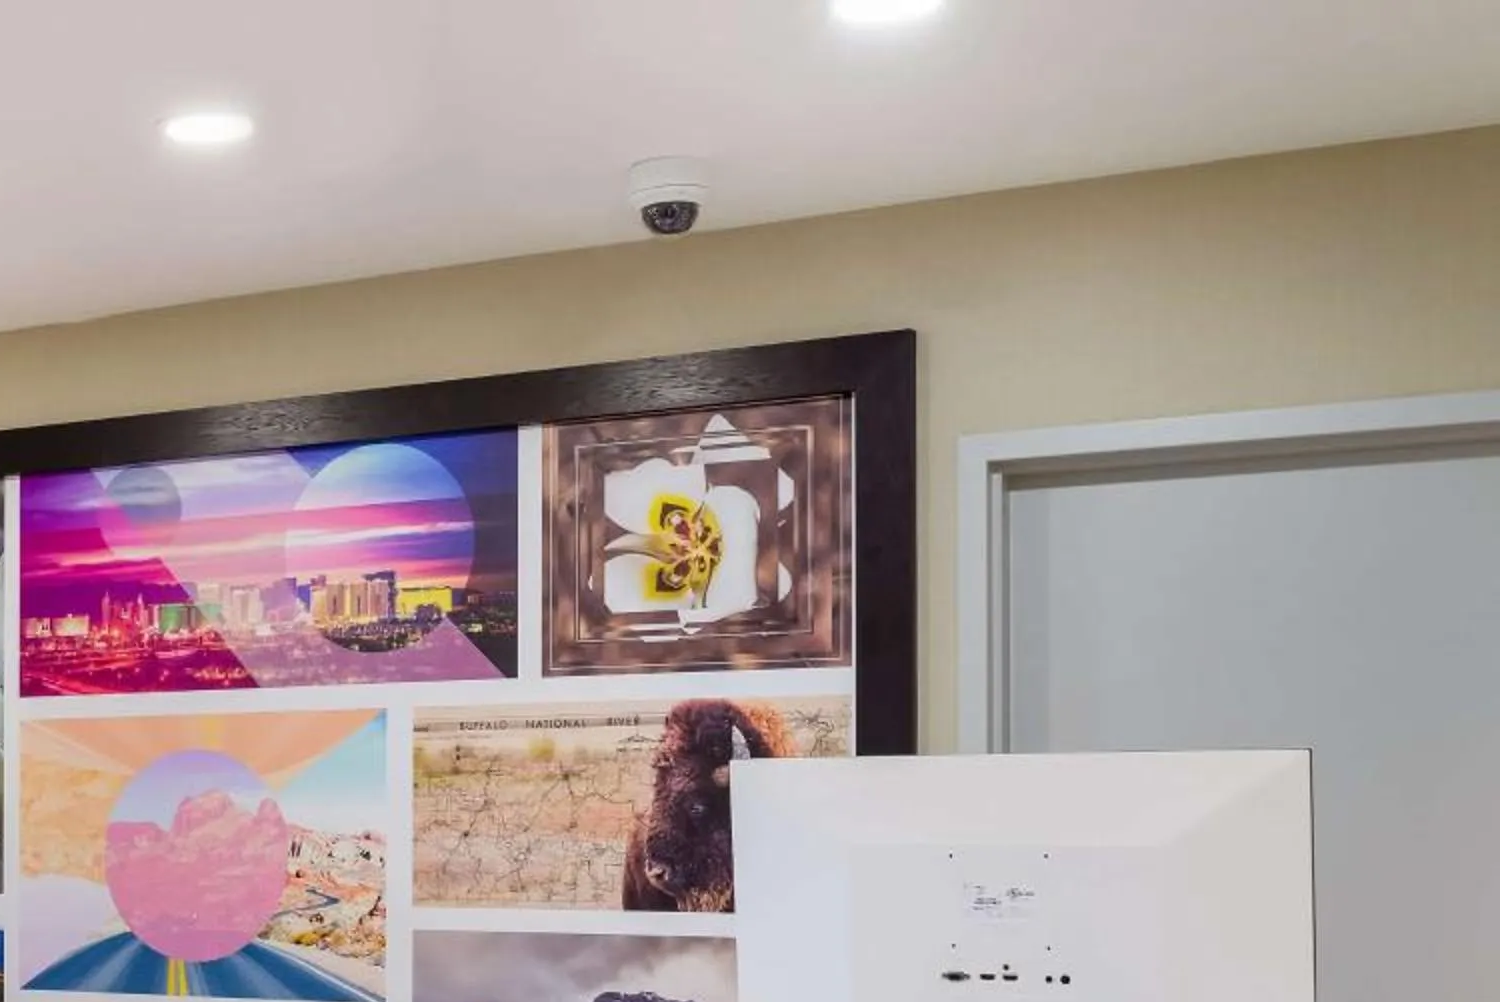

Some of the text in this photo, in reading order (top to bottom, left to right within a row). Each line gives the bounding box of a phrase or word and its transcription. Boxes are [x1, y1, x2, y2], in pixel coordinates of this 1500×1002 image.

[459, 715, 640, 731] BUFFALO NATIONAL RIVER
